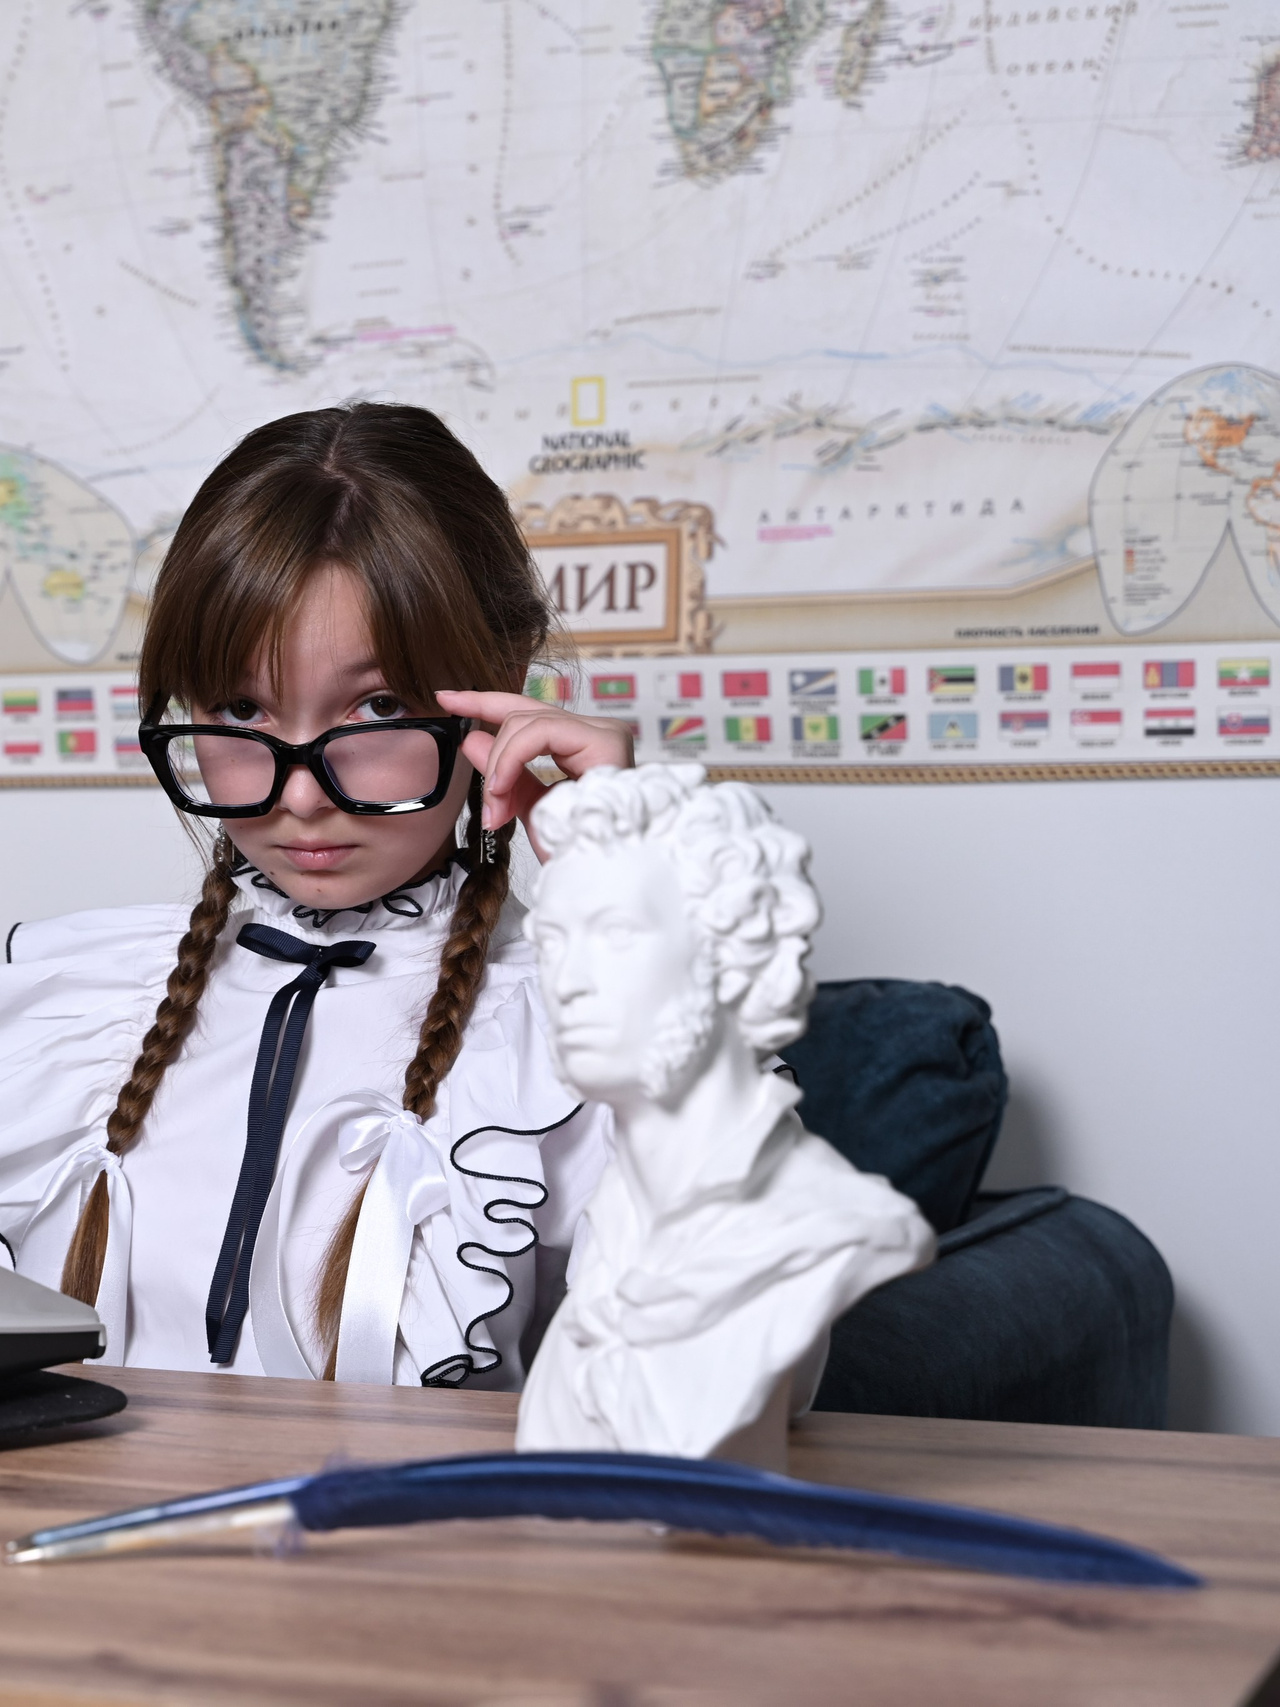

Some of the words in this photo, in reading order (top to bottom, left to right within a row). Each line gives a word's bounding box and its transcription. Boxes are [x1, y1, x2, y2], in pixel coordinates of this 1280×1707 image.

[542, 430, 631, 450] NATIONAL
[529, 450, 646, 475] GEOGRAPHIC
[758, 497, 1024, 524] АНТАРКТИДА
